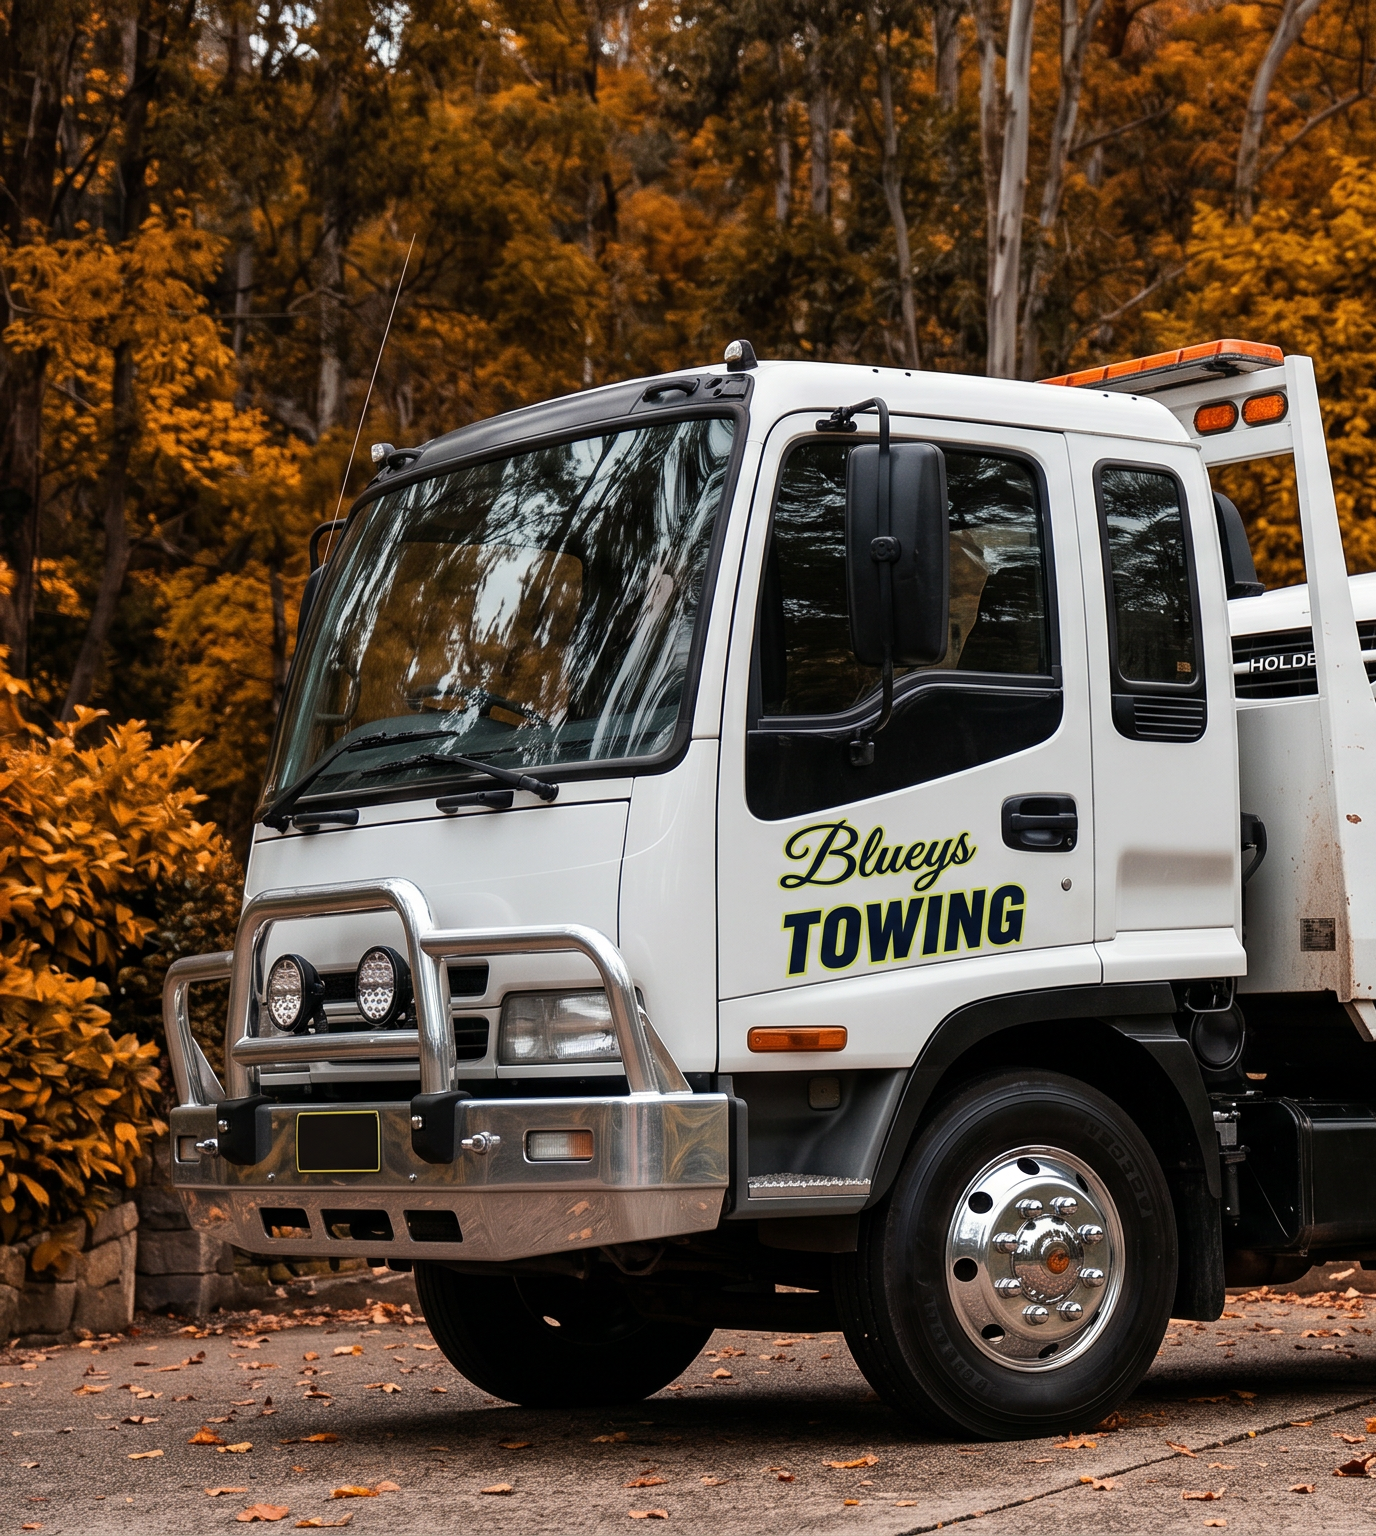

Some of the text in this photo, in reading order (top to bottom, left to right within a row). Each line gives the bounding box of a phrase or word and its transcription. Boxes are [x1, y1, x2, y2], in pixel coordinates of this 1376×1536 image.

[1250, 652, 1316, 673] HOLDE
[779, 818, 977, 892] Blueys
[781, 883, 1026, 976] TOWING
